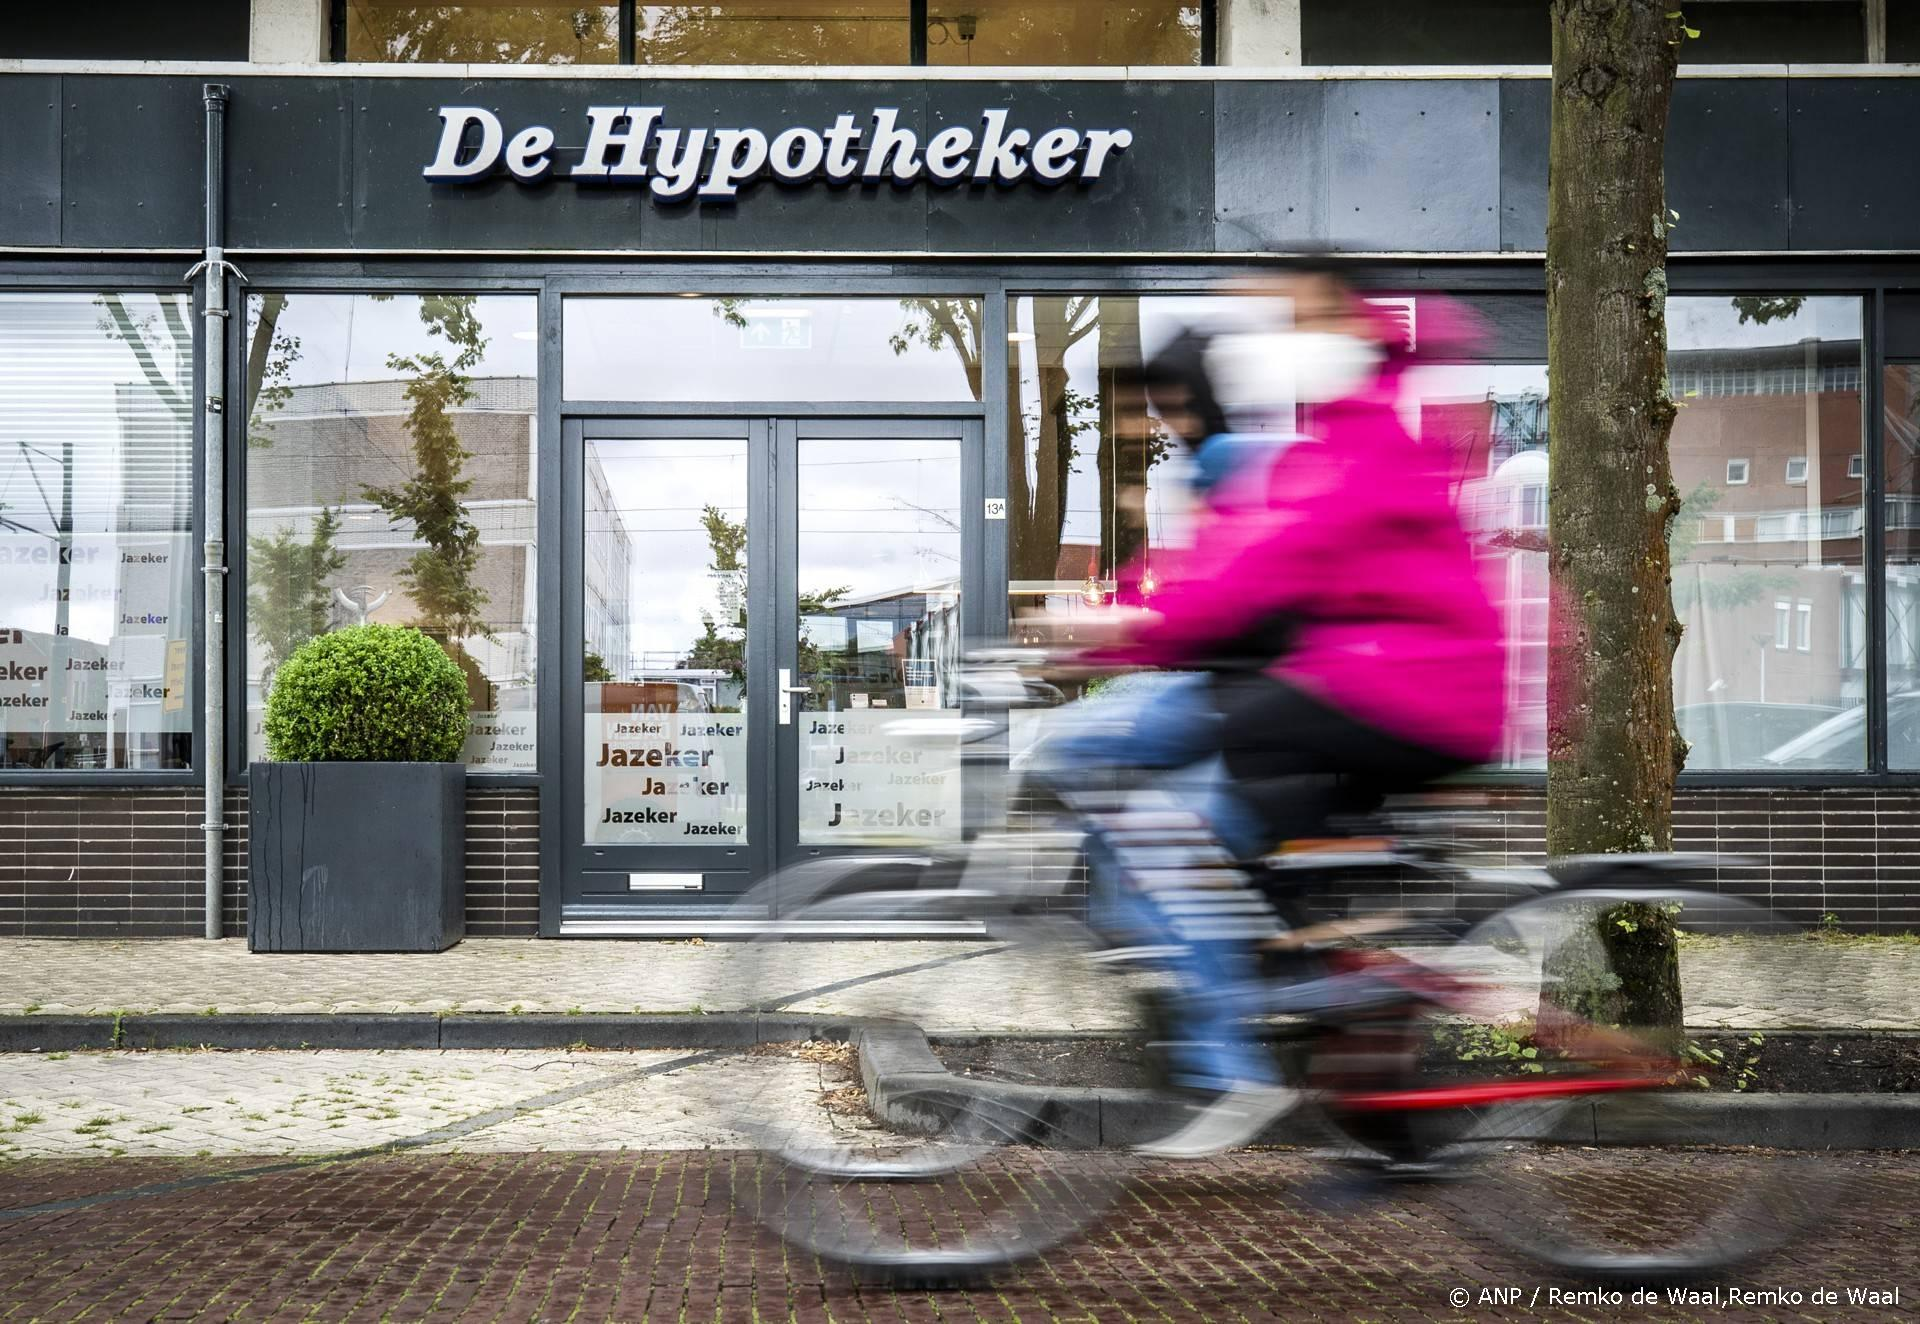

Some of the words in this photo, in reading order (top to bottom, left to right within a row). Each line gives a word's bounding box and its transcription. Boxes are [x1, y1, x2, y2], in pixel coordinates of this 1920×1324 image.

[422, 105, 555, 180] De
[570, 105, 1133, 197] Hypotheker
[987, 504, 1004, 514] 13A
[121, 553, 168, 563] Jazeker
[120, 614, 168, 624] Jazeker
[65, 658, 124, 671] Jazeker
[0, 693, 48, 707] zeker
[467, 723, 526, 736] Jazeker
[615, 723, 661, 734] Jazeker
[680, 723, 742, 737] Jazeker
[489, 741, 534, 751] Jazeker
[596, 742, 714, 767] Jazeker
[835, 746, 922, 765] Jazeker
[602, 807, 678, 824] Jazeker
[684, 822, 742, 836] Jazeker
